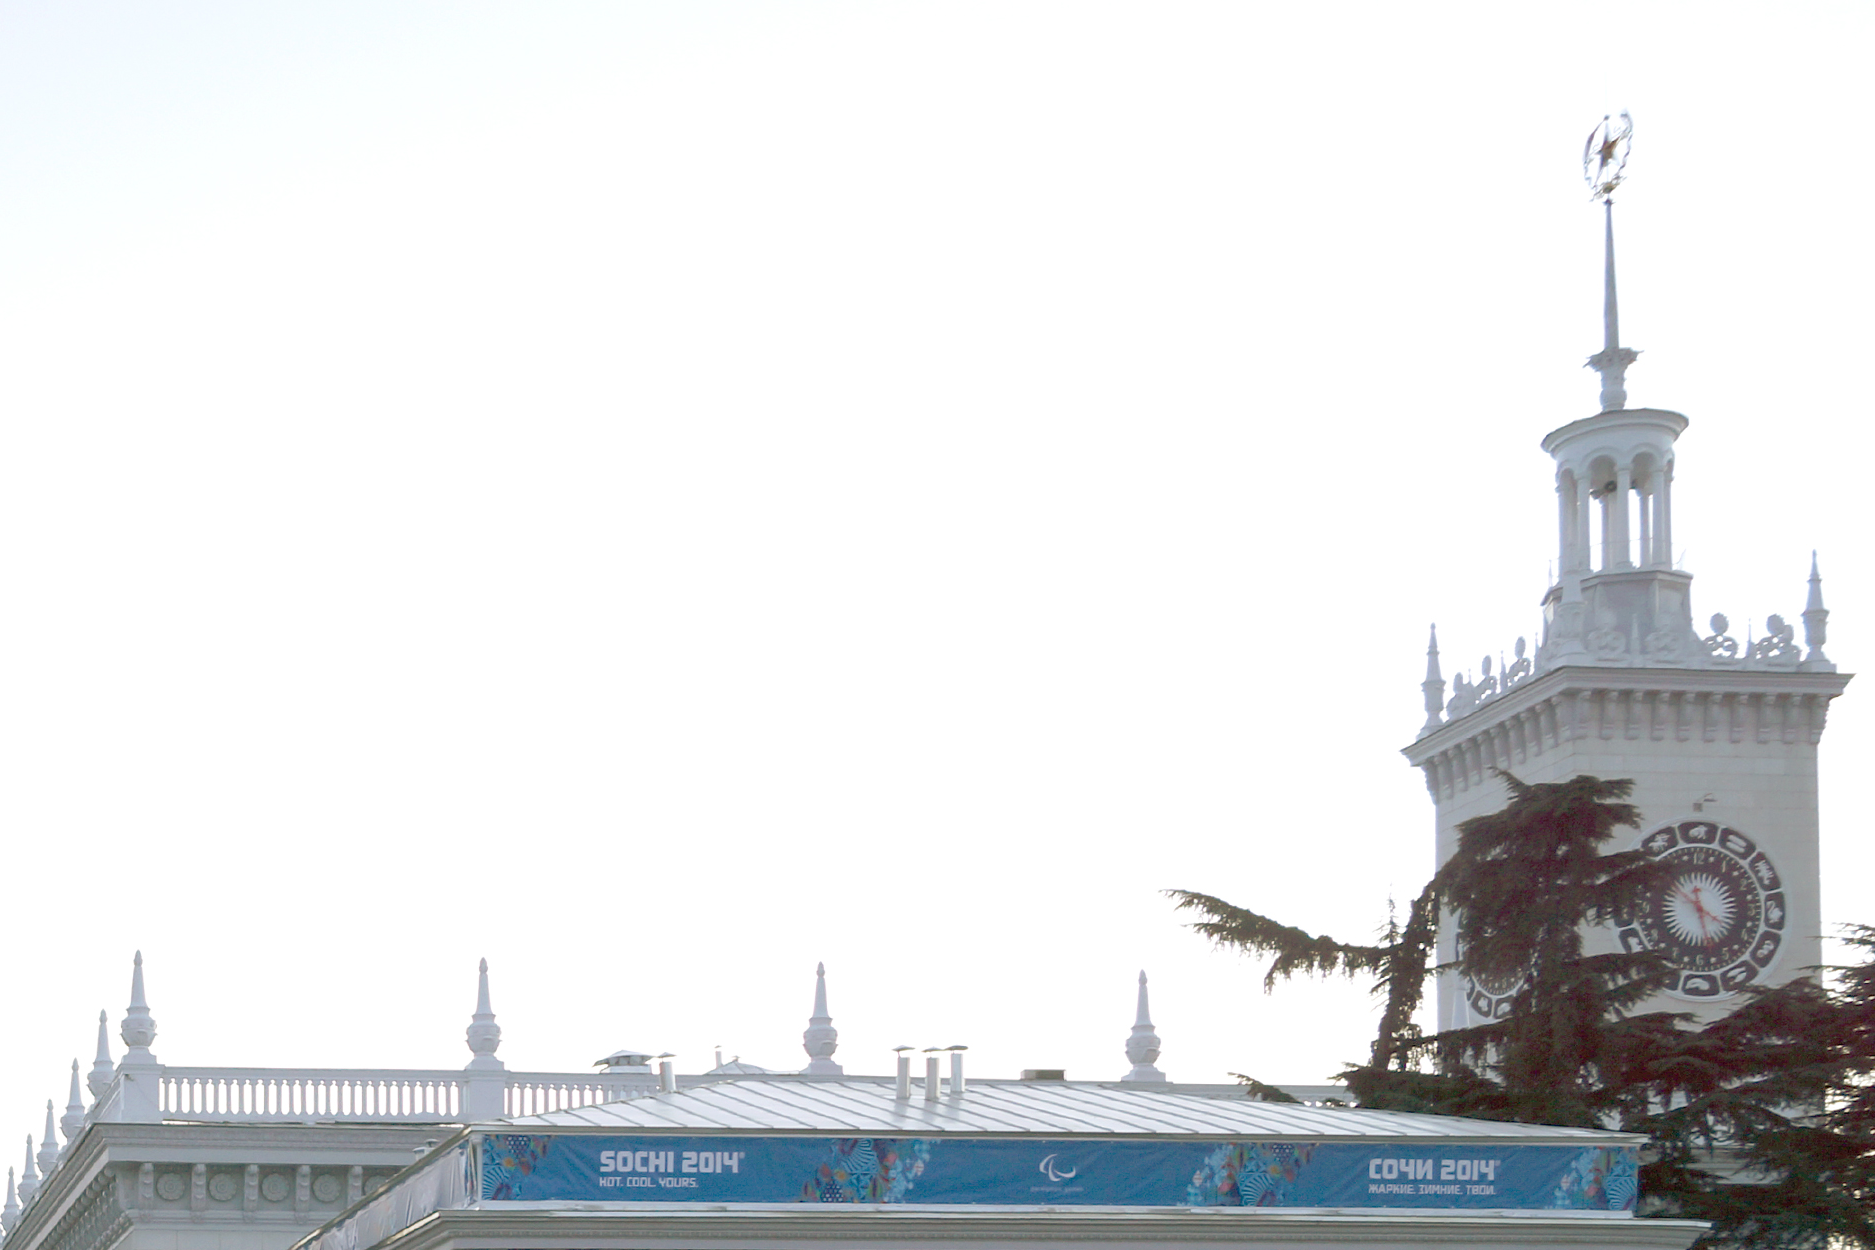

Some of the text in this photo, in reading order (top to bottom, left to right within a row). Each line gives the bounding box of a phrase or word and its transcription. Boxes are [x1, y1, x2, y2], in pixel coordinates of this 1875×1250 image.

[599, 1150, 739, 1174] SOCHI 2014
[1368, 1158, 1495, 1181] СОЧИ 2014
[599, 1176, 624, 1187] HOT.
[659, 1177, 699, 1188] YOURS.
